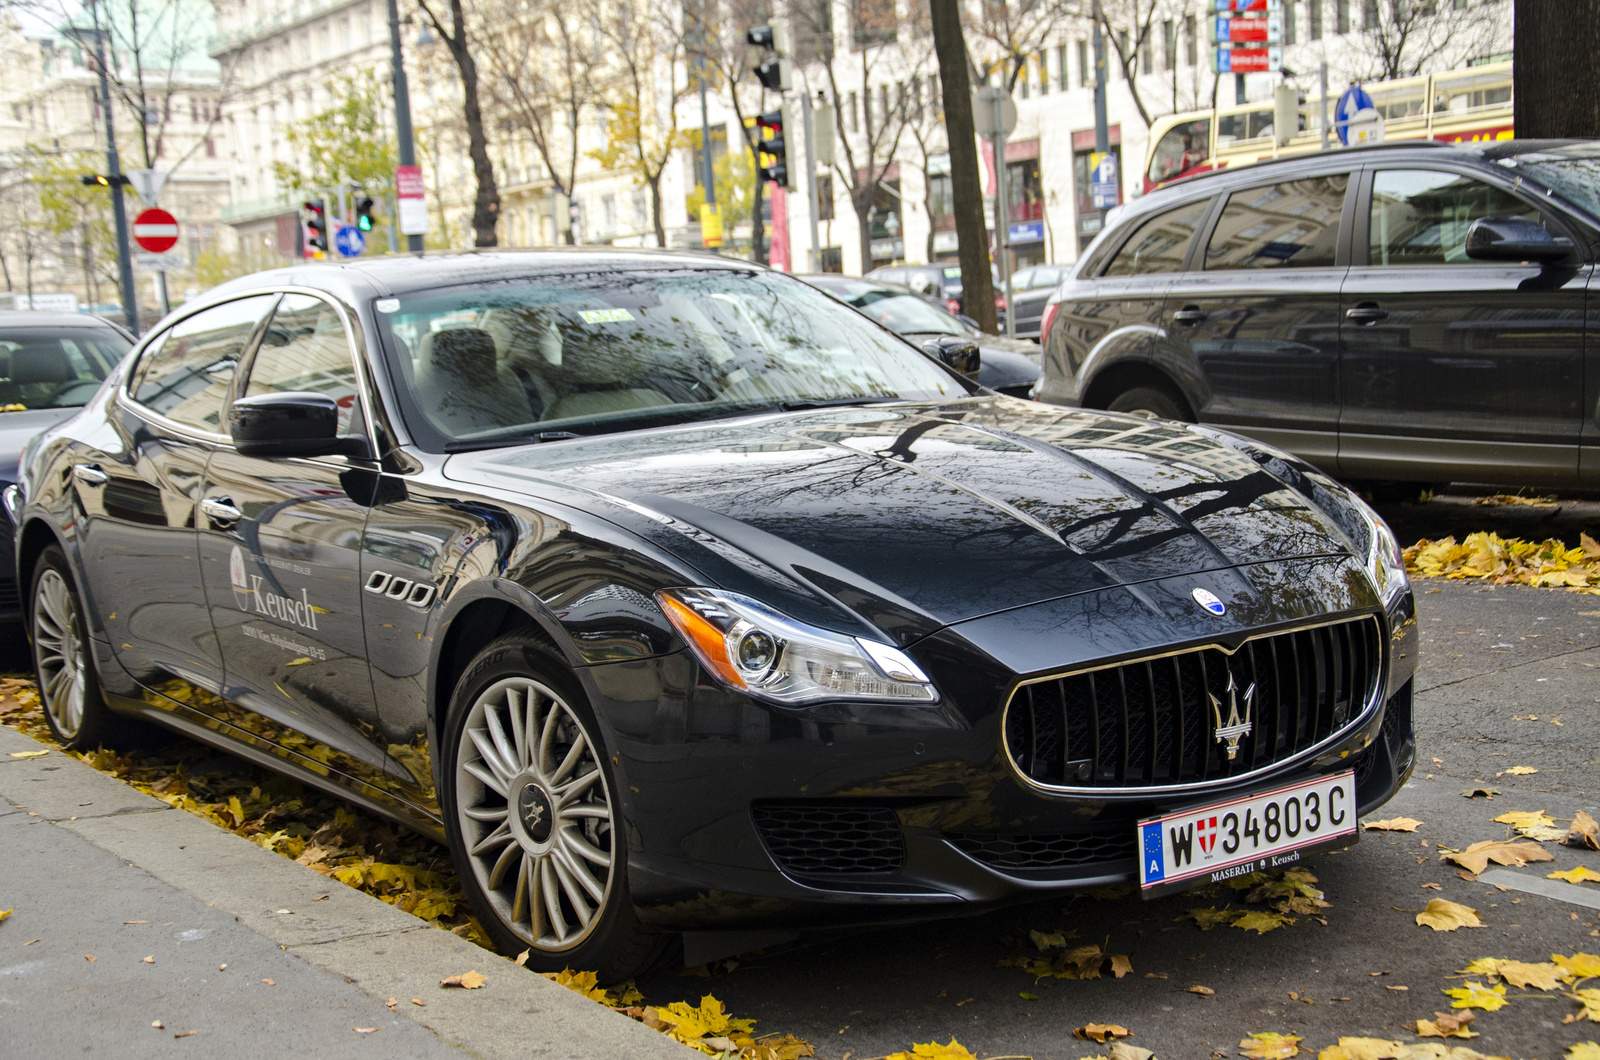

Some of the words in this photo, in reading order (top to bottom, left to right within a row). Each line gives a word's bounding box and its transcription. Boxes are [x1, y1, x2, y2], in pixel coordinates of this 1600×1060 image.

[1099, 162, 1115, 184] P
[293, 564, 312, 576] DEALER
[250, 574, 319, 631] Keusch
[1170, 822, 1193, 868] W
[1149, 859, 1160, 874] A
[1211, 862, 1255, 883] MASERATI
[1271, 850, 1300, 867] Keusch
